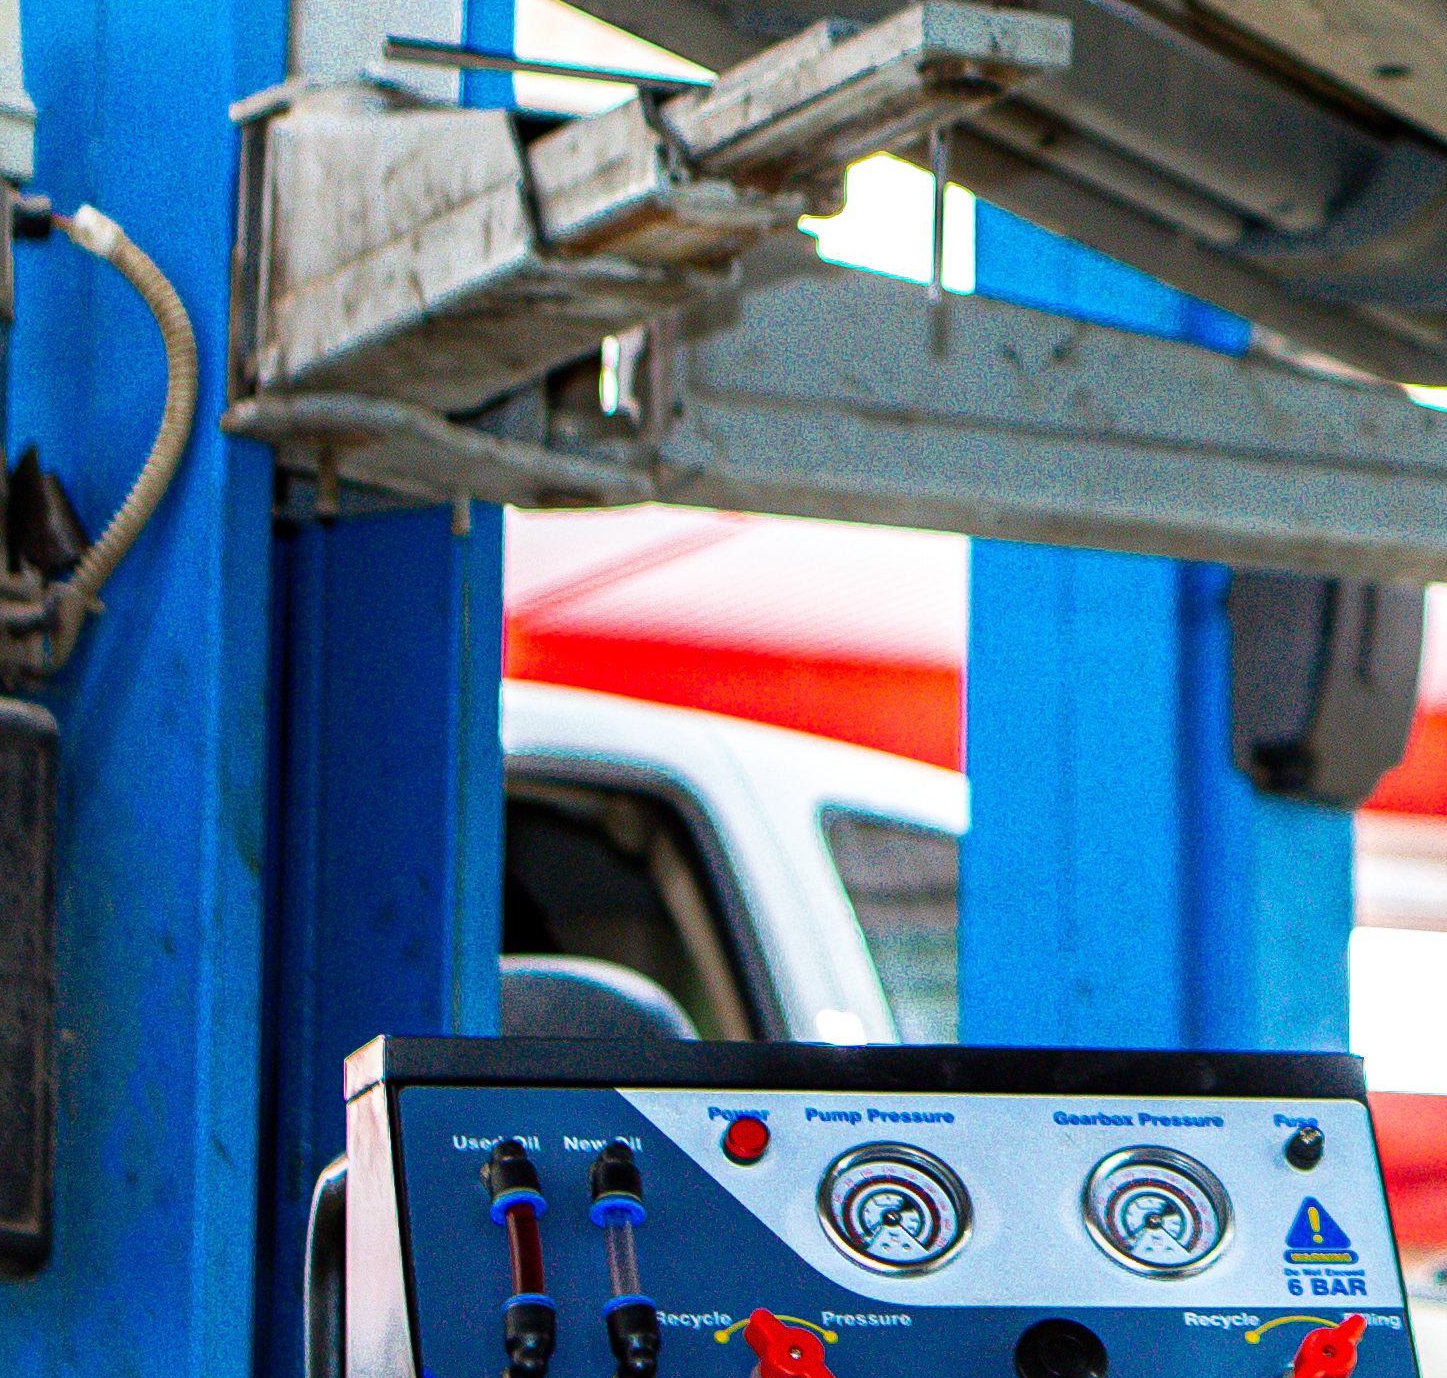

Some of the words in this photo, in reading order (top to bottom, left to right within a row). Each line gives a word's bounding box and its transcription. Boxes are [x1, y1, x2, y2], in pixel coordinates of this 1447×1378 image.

[804, 1107, 863, 1126] Pump
[866, 1108, 955, 1124] Pressure
[1053, 1110, 1134, 1126] Gearbox
[1137, 1112, 1224, 1128] Pressure
[1287, 1278, 1303, 1296] 6
[1310, 1277, 1368, 1296] BAR
[821, 1310, 912, 1327] Pressure
[1183, 1311, 1262, 1330] Recycle
